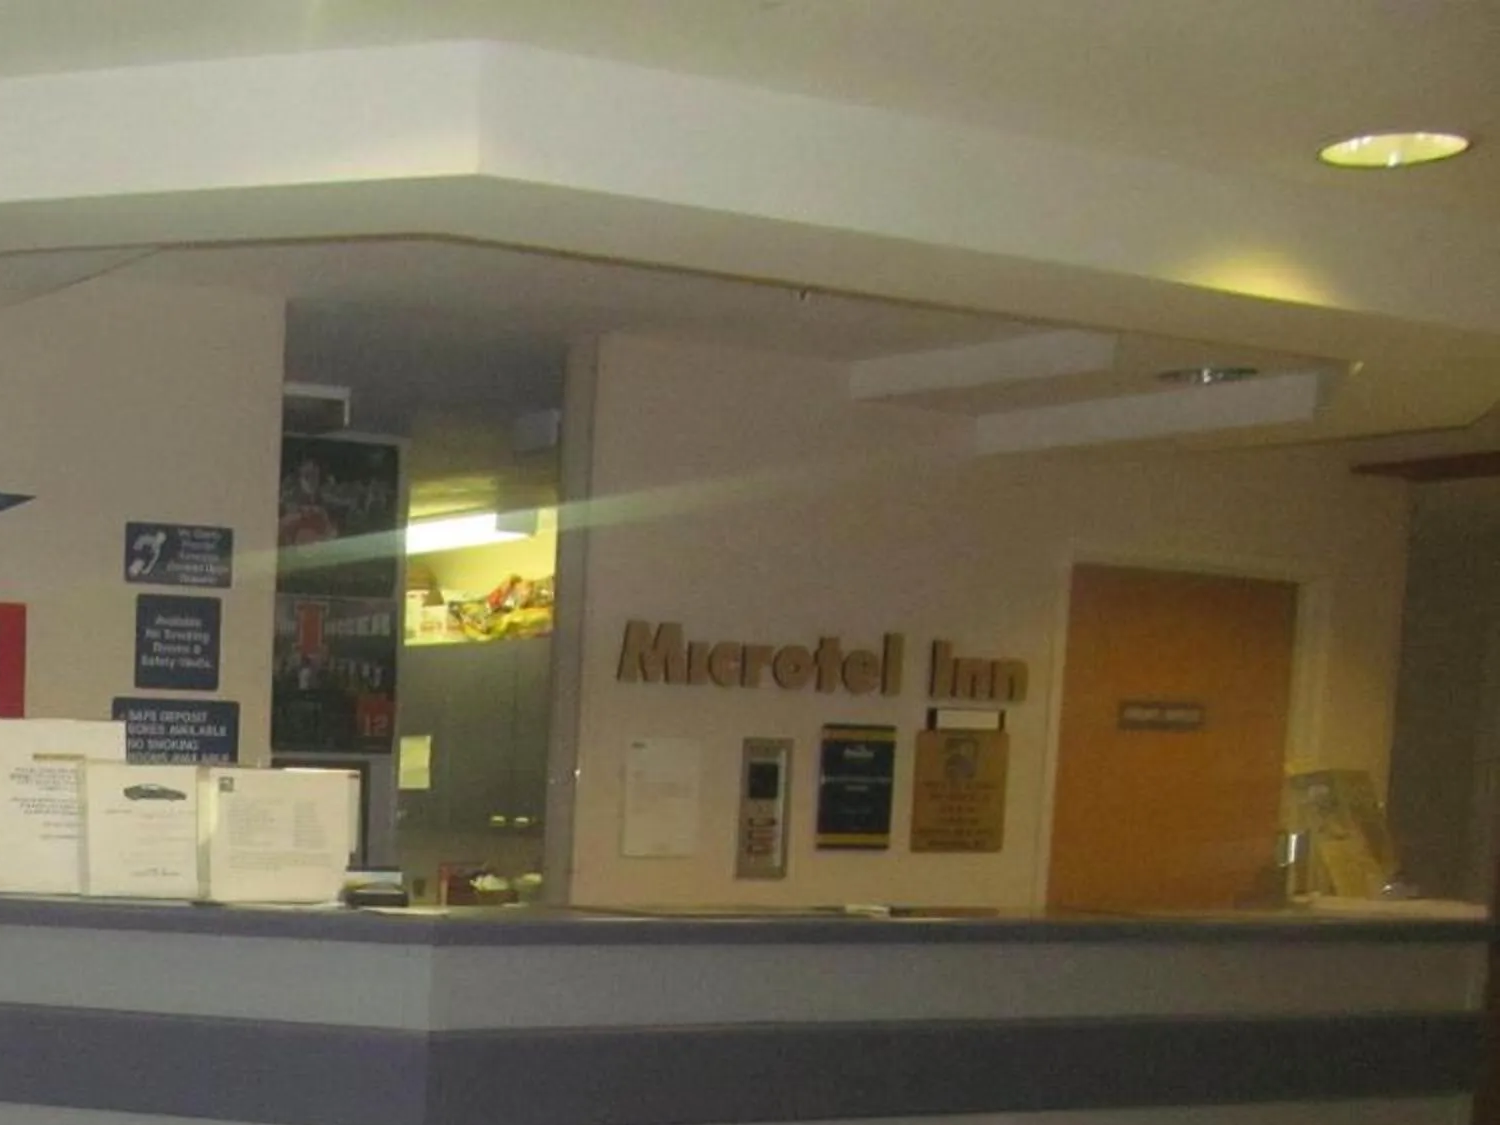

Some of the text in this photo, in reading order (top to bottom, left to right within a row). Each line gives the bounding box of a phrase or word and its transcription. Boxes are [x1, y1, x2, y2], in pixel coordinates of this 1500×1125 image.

[617, 619, 1029, 700] Microtel Inn
[160, 710, 209, 722] DEPOSIT
[169, 724, 228, 737] AVAILABLE
[148, 738, 200, 751] SMOKING
